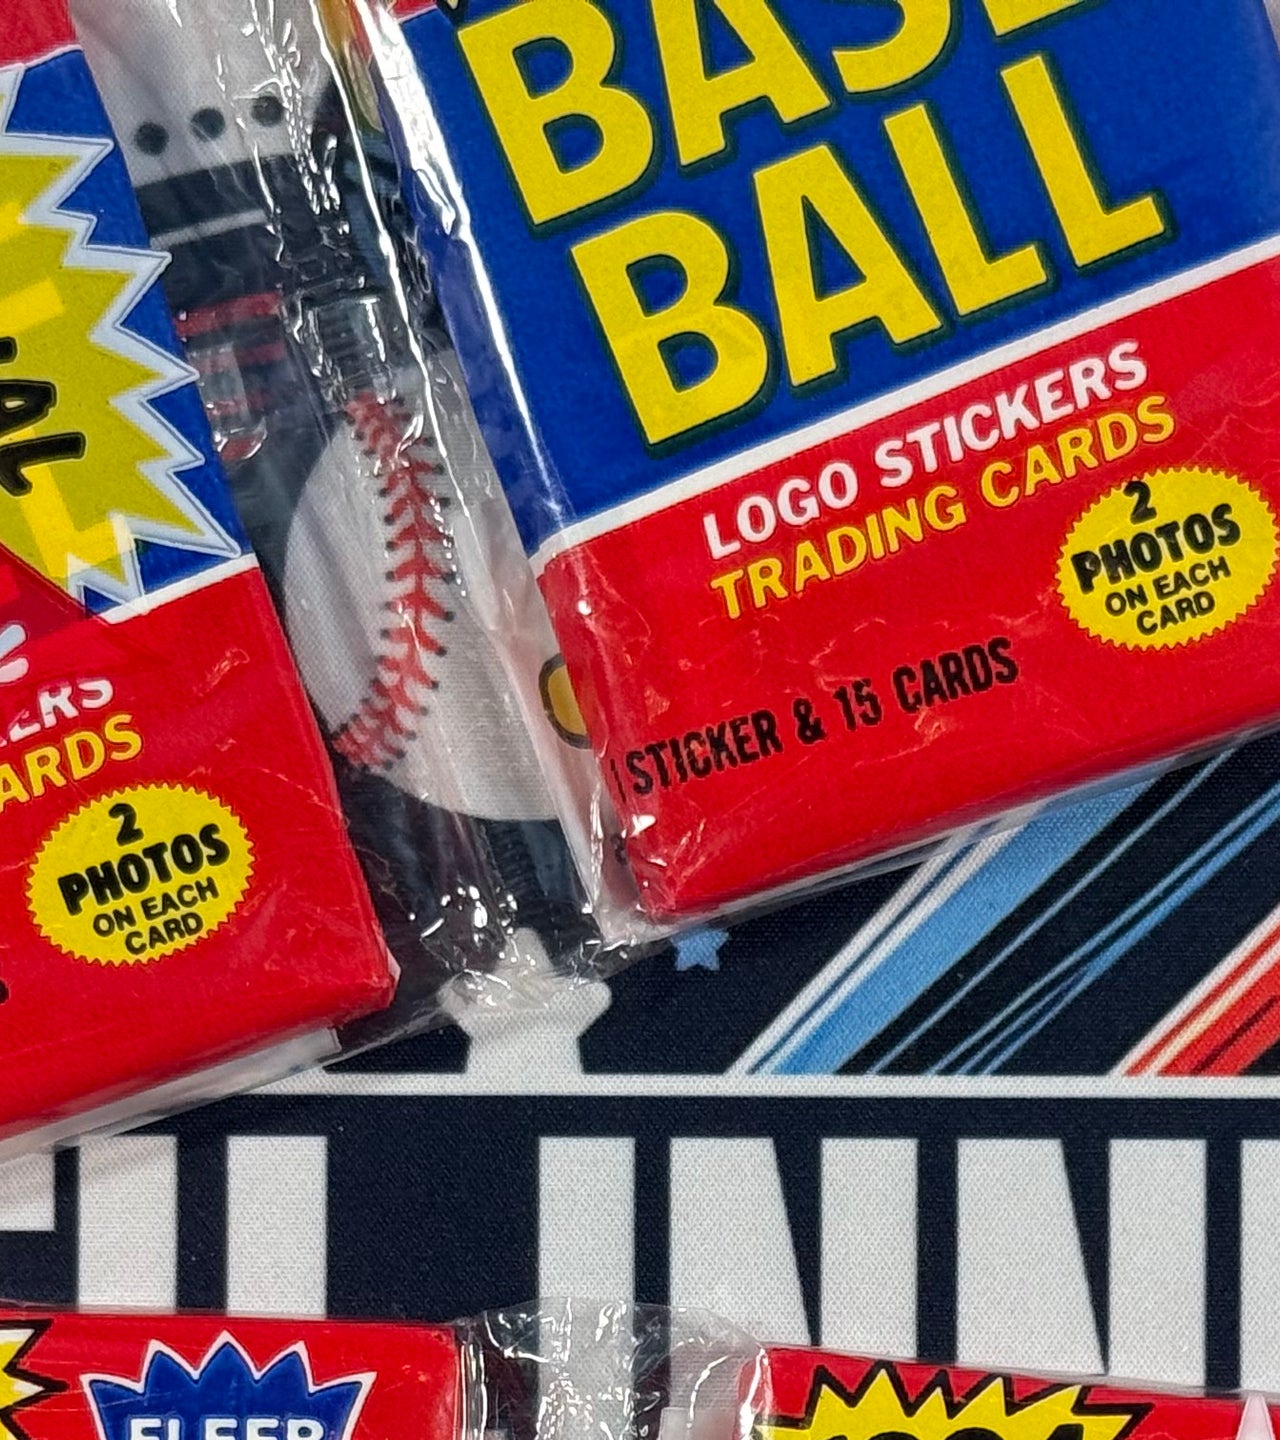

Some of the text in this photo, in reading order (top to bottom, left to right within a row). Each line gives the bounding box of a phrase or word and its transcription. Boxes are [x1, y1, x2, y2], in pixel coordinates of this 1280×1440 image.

[458, 0, 1091, 226] BA
[570, 56, 1165, 445] BALL
[702, 341, 1148, 560] LOGO STICKERS
[709, 394, 1176, 619] TRADING CARDS
[1124, 483, 1156, 522] 2
[1073, 501, 1241, 595] PHOTOS
[1105, 558, 1231, 617] ON EACH
[1135, 589, 1215, 637] CARD
[626, 709, 783, 796] STICKER
[793, 697, 826, 744] &
[833, 679, 883, 731] 15
[893, 637, 1019, 714] CARDS
[58, 824, 230, 914] PHOTOS
[109, 803, 143, 846] 2
[93, 876, 220, 938] ON EACH
[125, 911, 204, 957] CARD
